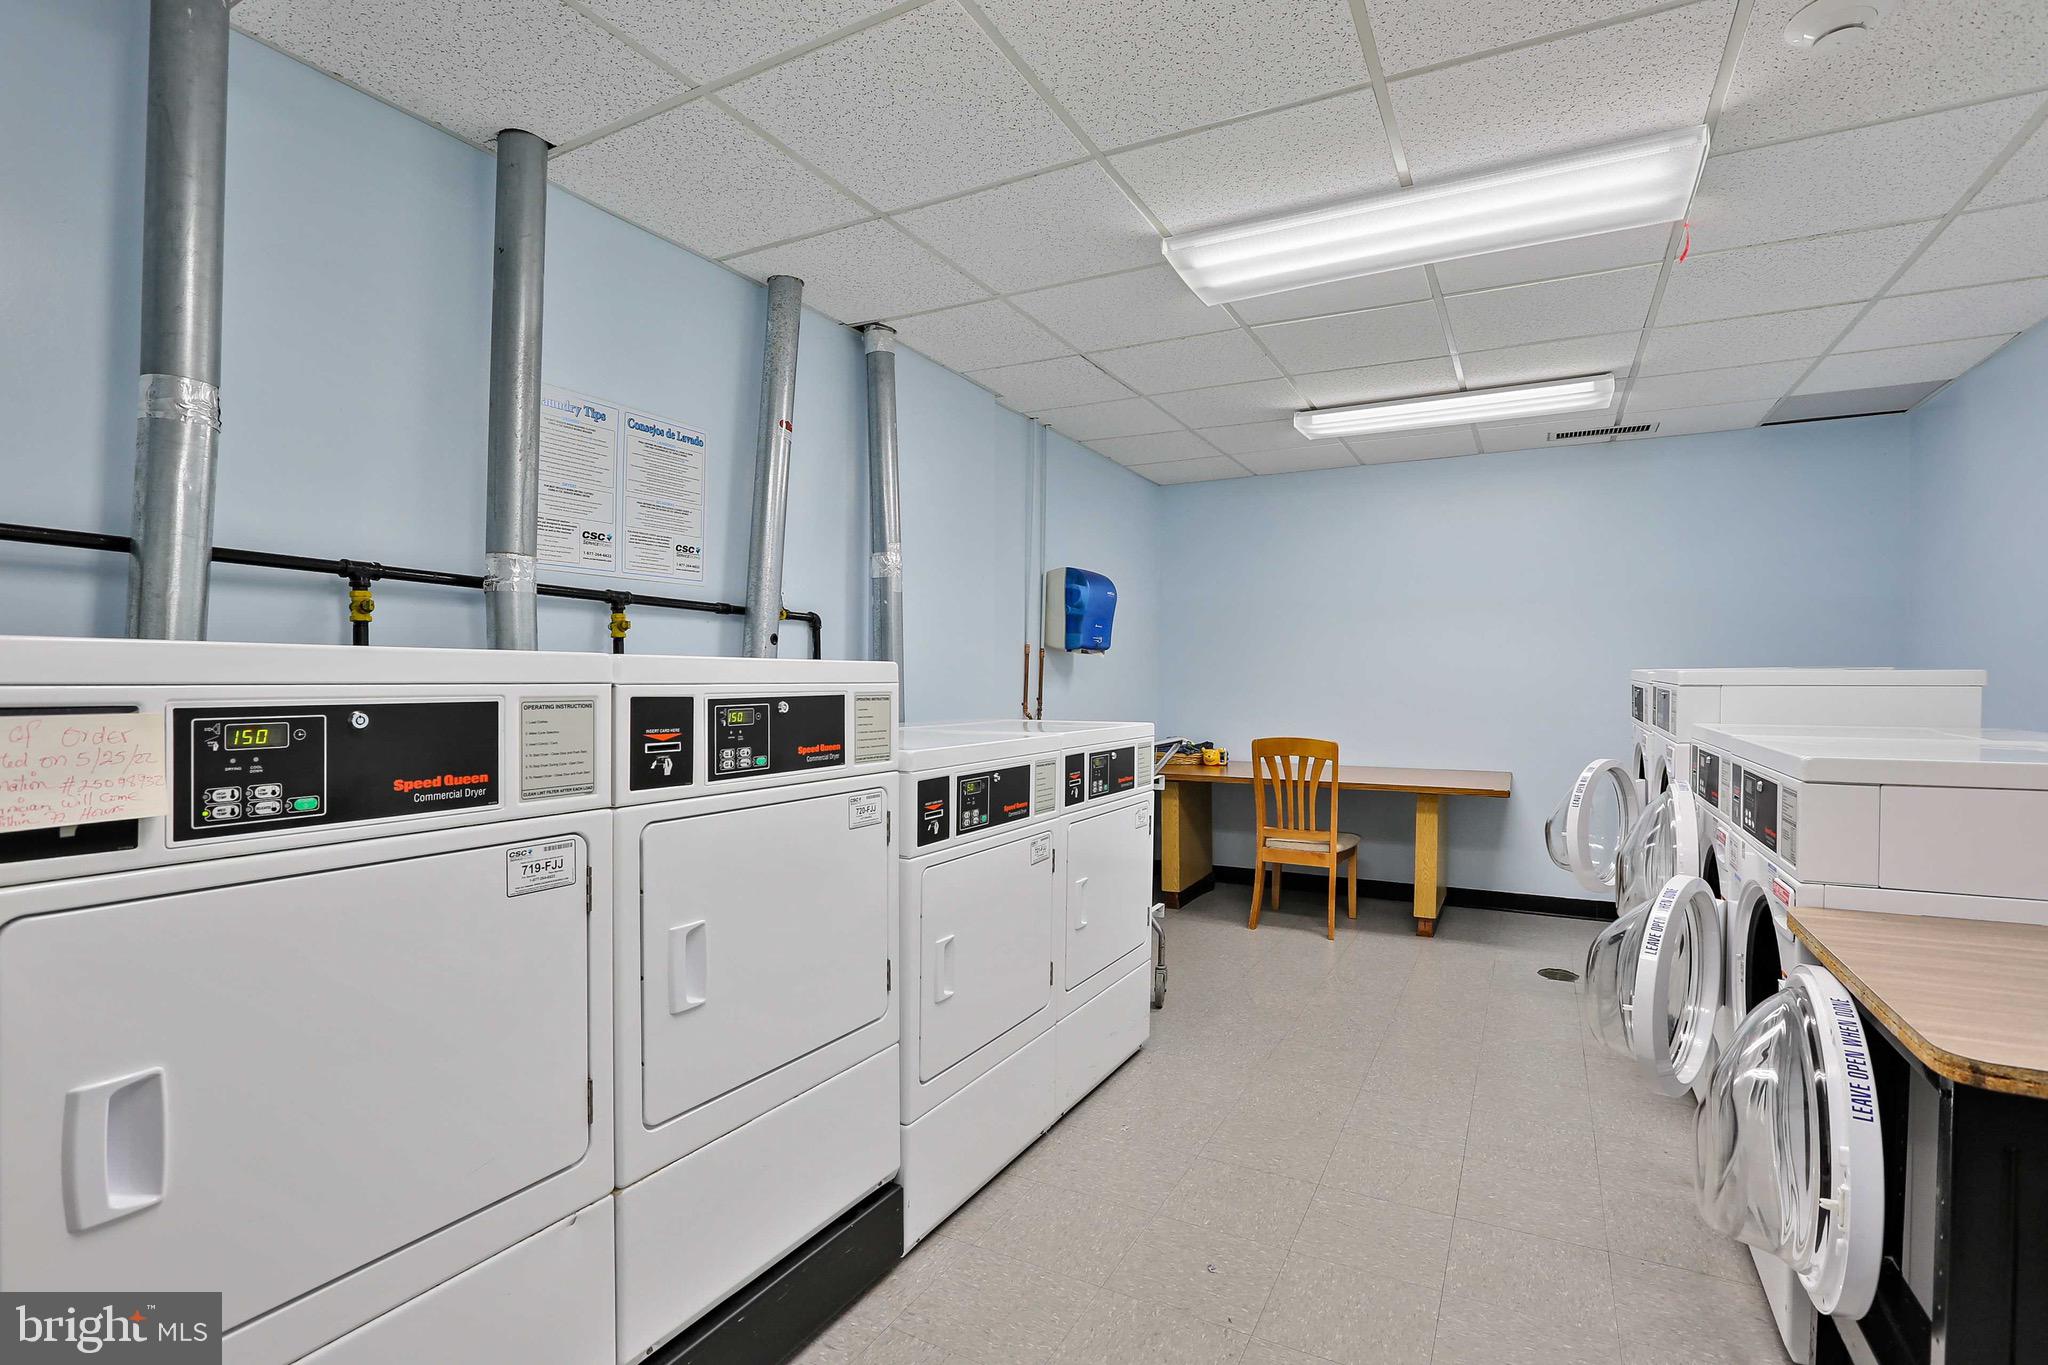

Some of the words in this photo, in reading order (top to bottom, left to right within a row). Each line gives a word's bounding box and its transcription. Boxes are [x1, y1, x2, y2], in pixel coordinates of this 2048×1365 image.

[543, 399, 582, 417] aundry
[583, 404, 607, 423] Tips
[627, 417, 664, 437] Consejos
[665, 427, 676, 440] de
[676, 430, 704, 448] Lavado
[582, 530, 606, 541] CSC
[675, 544, 695, 554] CSC
[728, 712, 743, 722] 150
[62, 726, 133, 748] Order
[233, 729, 268, 745] 150
[798, 744, 820, 755] Speed
[0, 753, 28, 769] ted
[393, 775, 442, 793] Speed
[444, 774, 489, 787] Queen
[413, 789, 463, 803] Commercial
[464, 787, 487, 798] Dryer
[856, 804, 877, 816] 720-FJJ
[509, 850, 527, 858] CSC
[522, 858, 564, 876] 719-FJJ
[1645, 933, 1661, 956] LEAVE
[1829, 997, 1855, 1019] DONE
[1838, 1020, 1863, 1048] WHEN
[1844, 1050, 1870, 1081] OPEN
[1849, 1082, 1874, 1123] LEAVE
